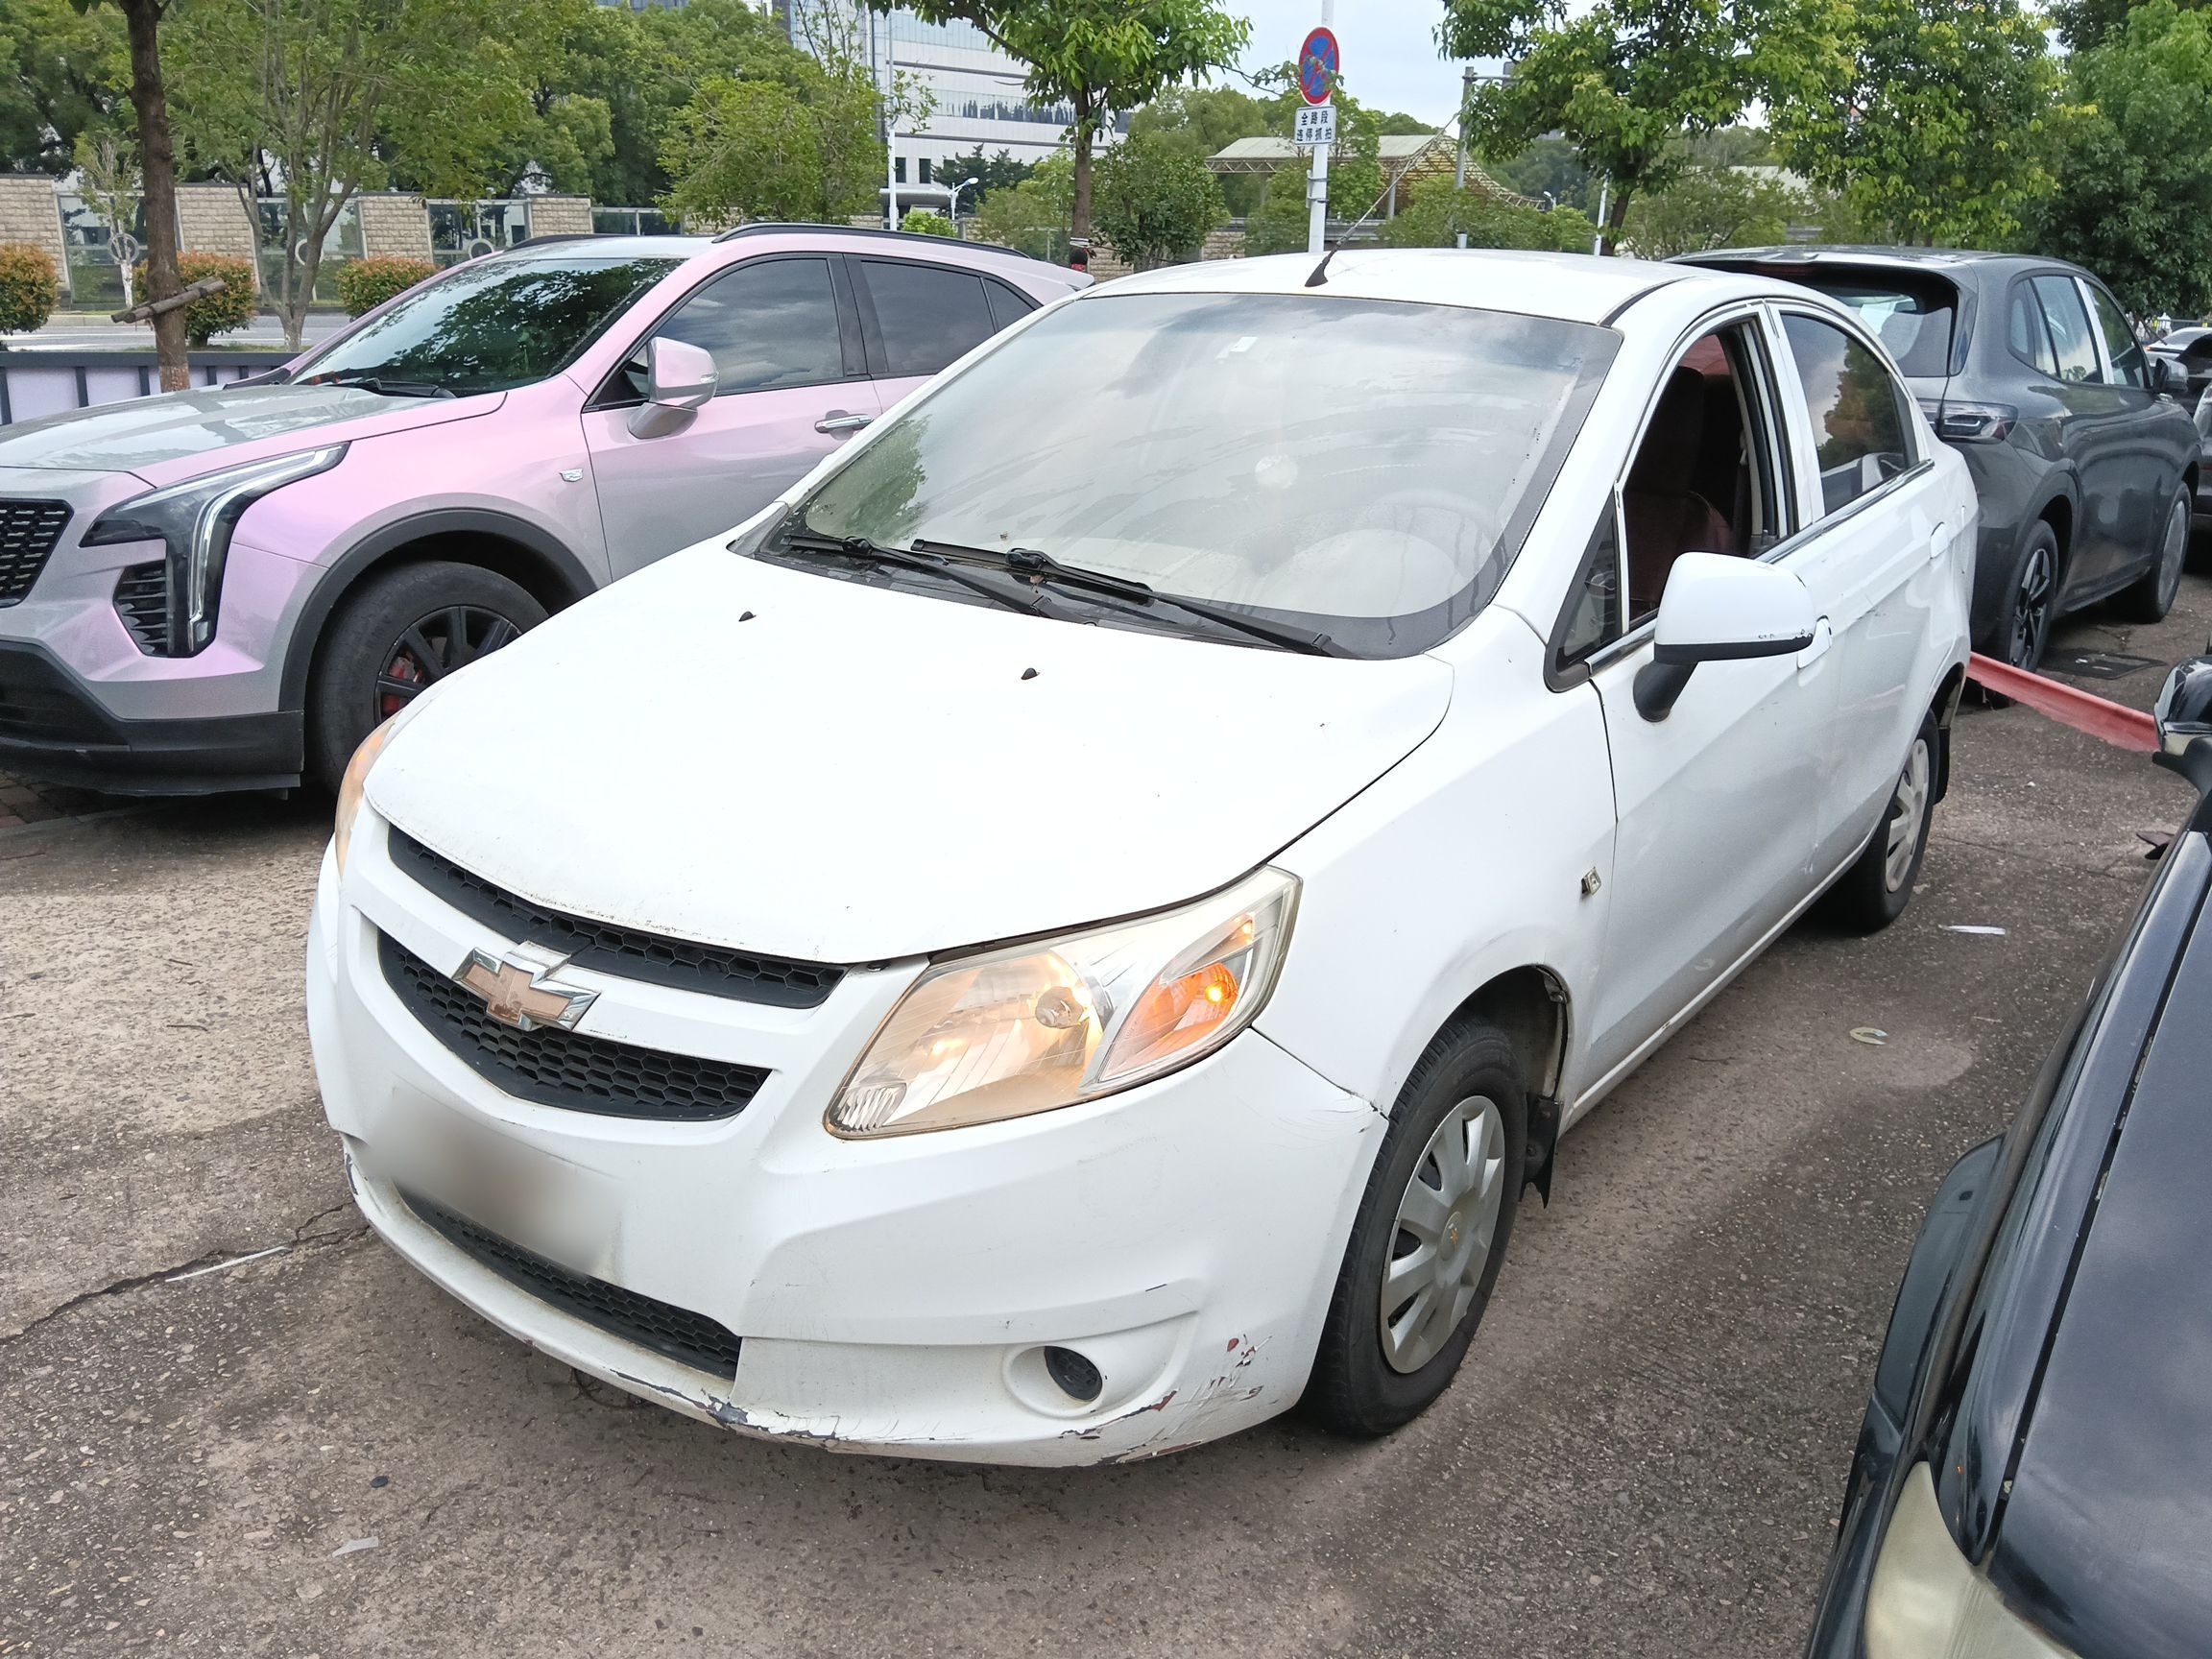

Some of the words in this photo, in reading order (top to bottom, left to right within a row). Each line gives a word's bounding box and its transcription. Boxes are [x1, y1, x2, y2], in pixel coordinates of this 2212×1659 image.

[1301, 110, 1329, 126] 全路段
[1296, 127, 1333, 142] 违停抓拍
